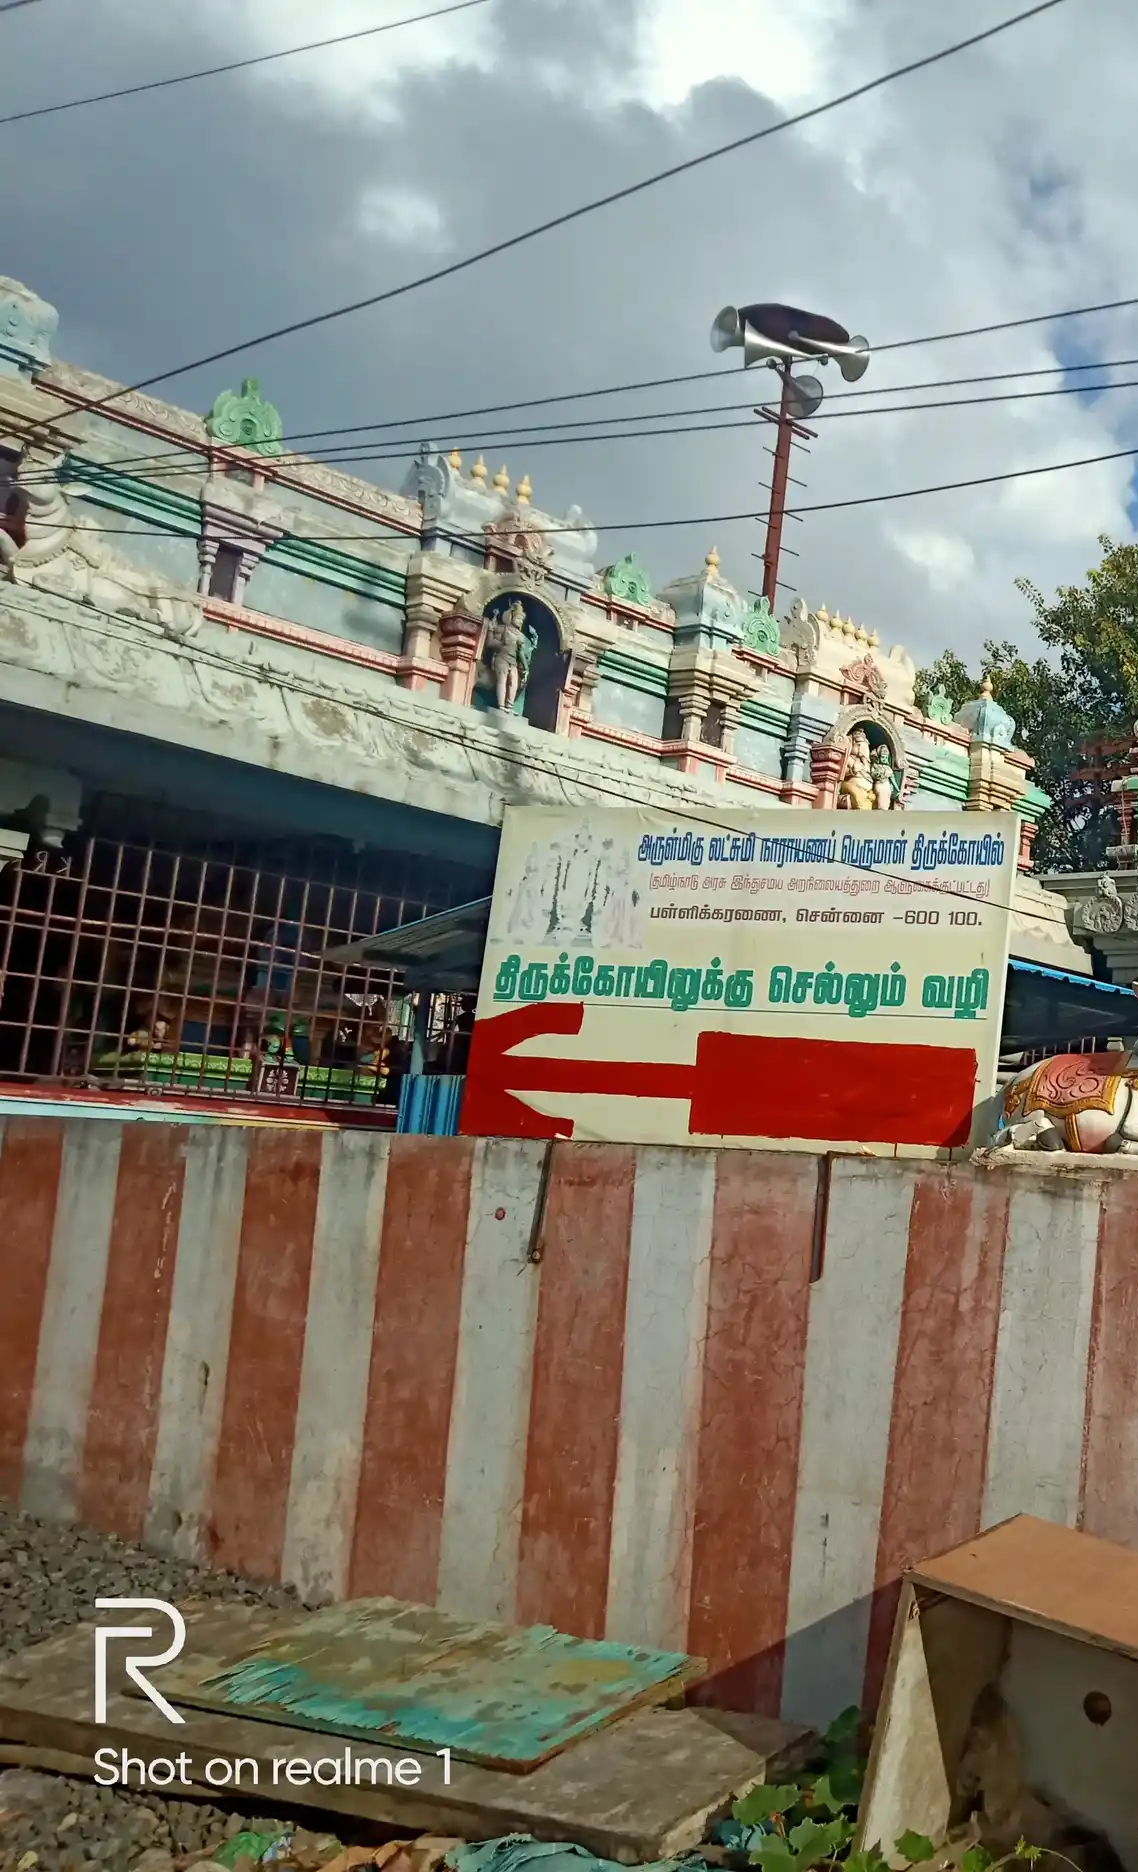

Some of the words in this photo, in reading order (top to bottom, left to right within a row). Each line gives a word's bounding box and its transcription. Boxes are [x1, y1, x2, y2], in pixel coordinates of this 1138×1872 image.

[637, 827, 704, 866] அருள்மிகு
[760, 829, 837, 868] நாராயணப்
[841, 829, 908, 869] பெருமாள்
[911, 830, 1005, 871] திருக்கோயில்
[702, 875, 727, 892] அரசு
[650, 902, 787, 924] பள்ளிக்கரணை,
[796, 907, 885, 925] சென்னை
[948, 911, 983, 926] 100.
[493, 951, 755, 1013] திருக்கோயிலுக்கு
[768, 960, 908, 1018] செல்லும்
[921, 967, 990, 1019] வழி
